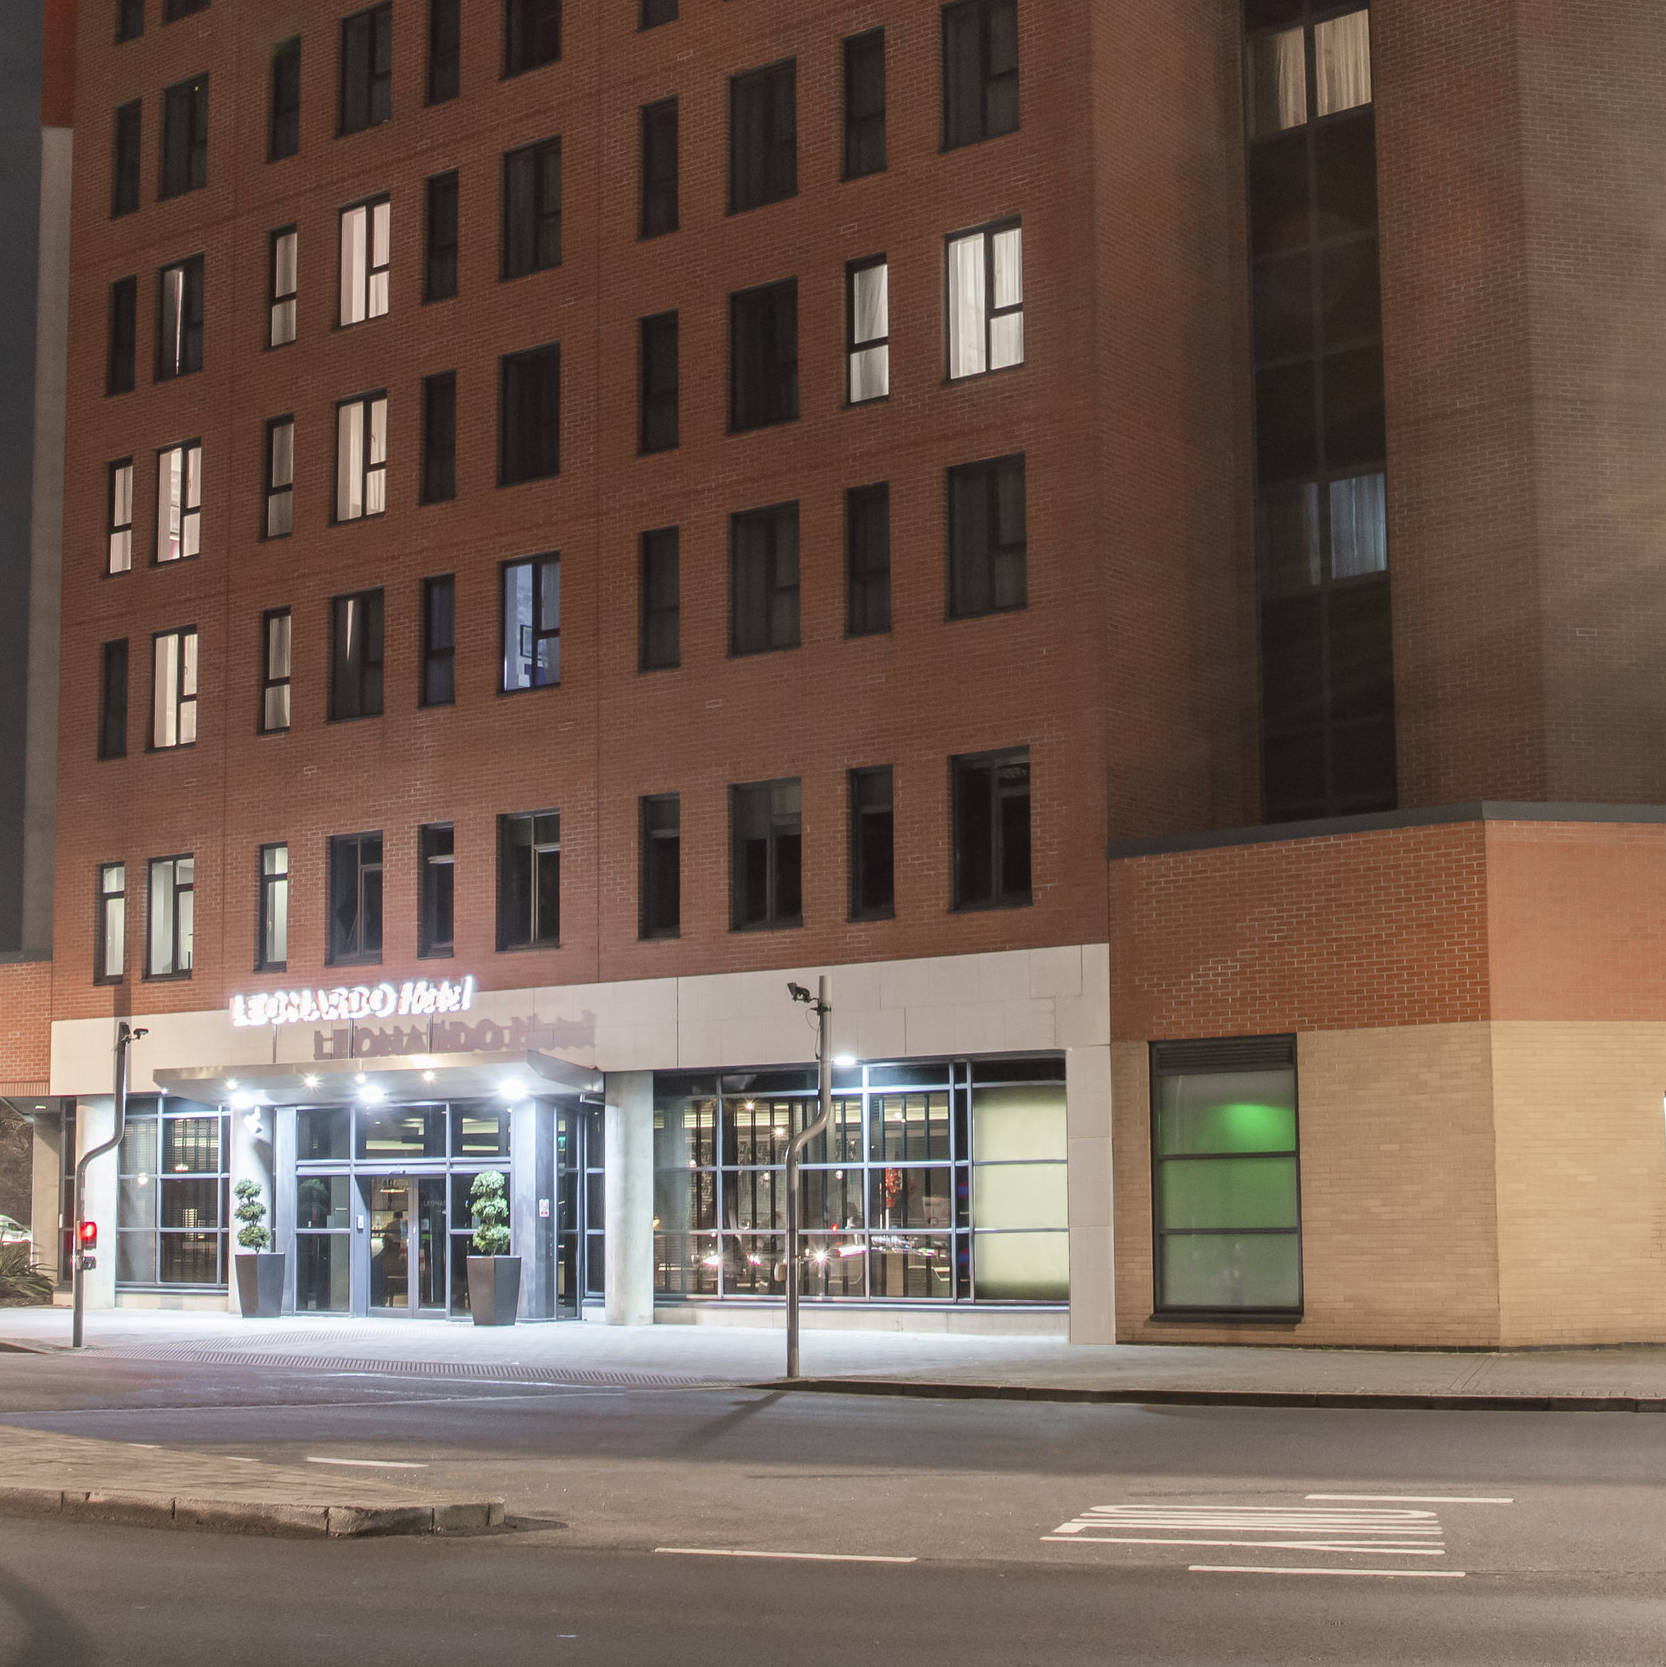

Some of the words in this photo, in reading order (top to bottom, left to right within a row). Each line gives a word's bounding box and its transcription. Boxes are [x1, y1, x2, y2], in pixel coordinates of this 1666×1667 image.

[231, 983, 398, 1027] LEONARDO
[397, 974, 474, 1016] Hotel
[1039, 1503, 1447, 1556] ONLY
